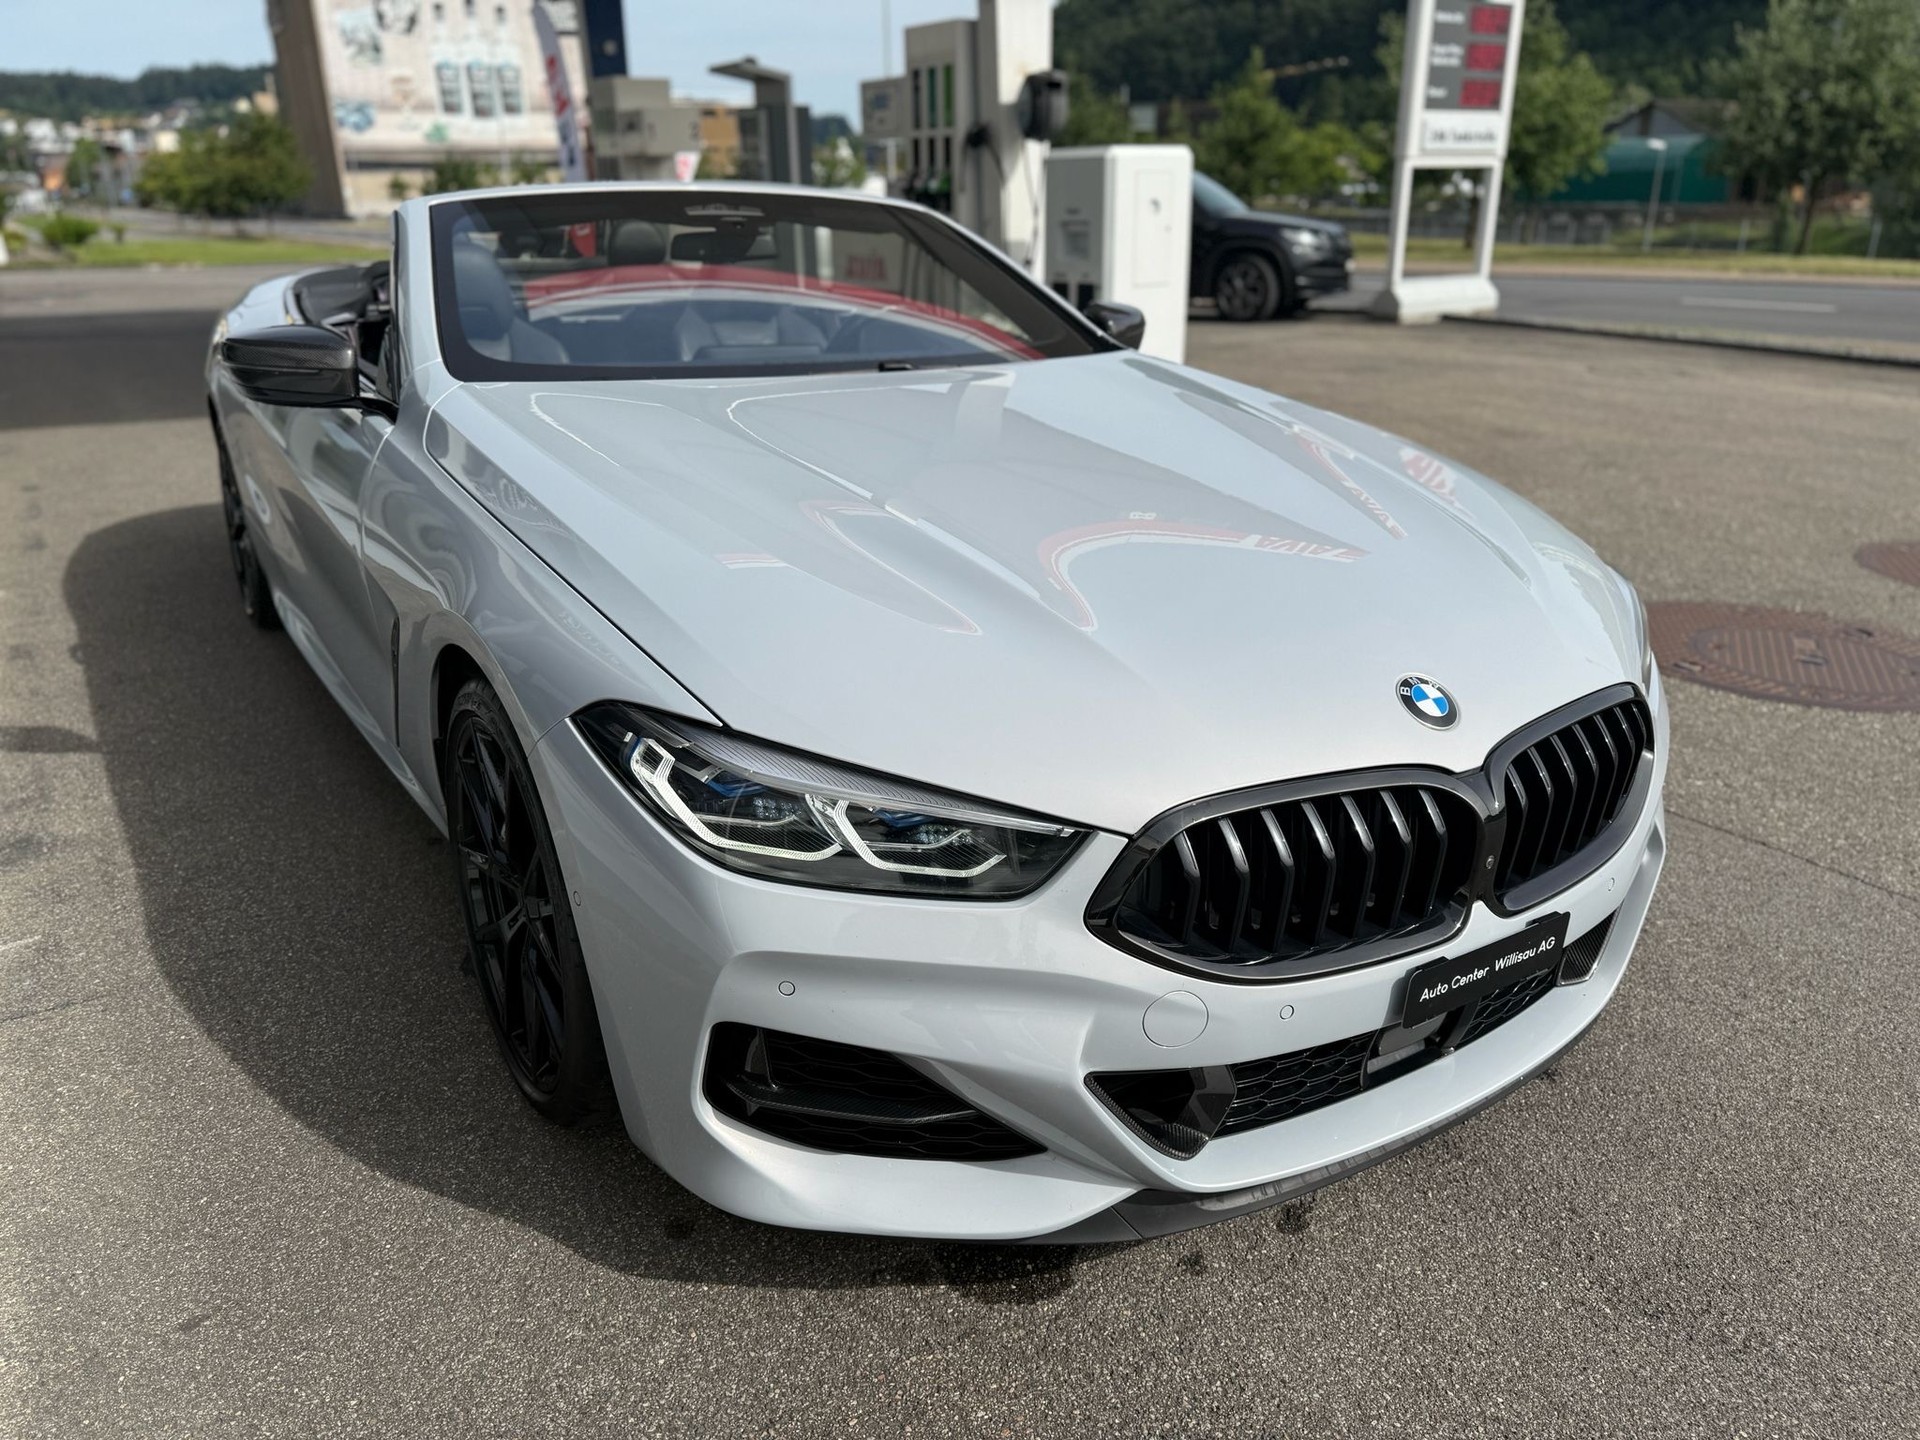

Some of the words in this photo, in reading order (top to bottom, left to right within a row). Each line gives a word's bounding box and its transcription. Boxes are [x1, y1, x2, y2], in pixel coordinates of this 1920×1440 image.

[1400, 676, 1439, 696] BMW
[1419, 982, 1449, 1002] Auto
[1451, 967, 1490, 989] Center
[1495, 947, 1537, 972] Willisau
[1537, 936, 1556, 954] AG
